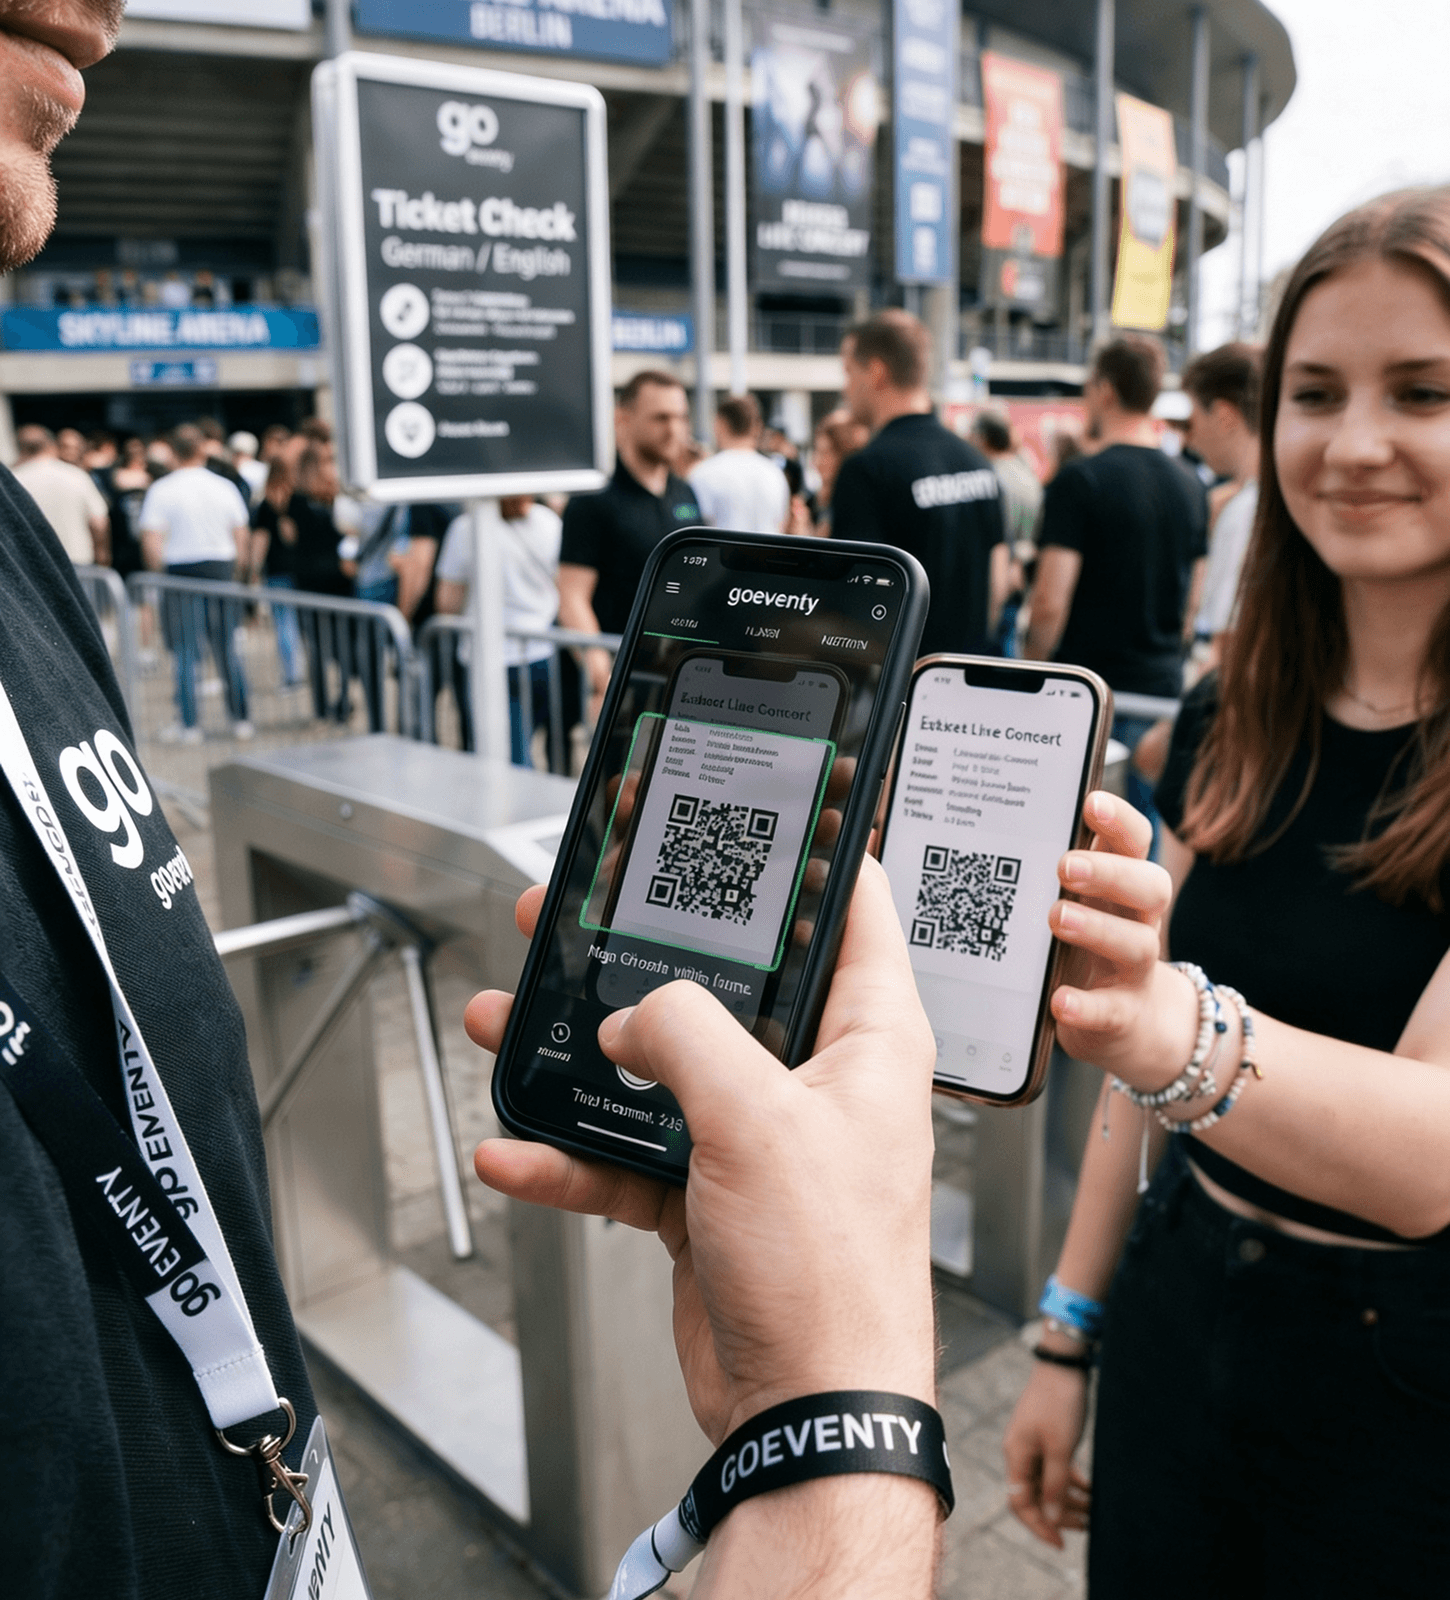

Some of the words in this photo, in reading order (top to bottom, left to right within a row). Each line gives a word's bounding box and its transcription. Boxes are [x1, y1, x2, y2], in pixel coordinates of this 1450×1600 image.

[436, 100, 499, 157] go
[371, 187, 479, 235] Ticket
[479, 196, 577, 242] Check
[380, 235, 476, 272] German
[475, 240, 492, 274] /
[492, 241, 571, 281] English
[174, 312, 270, 345] ARENA
[727, 586, 820, 616] goeventy
[59, 729, 153, 869] go
[95, 1166, 182, 1278] EVENTY
[721, 1413, 922, 1494] GOEVENTY
